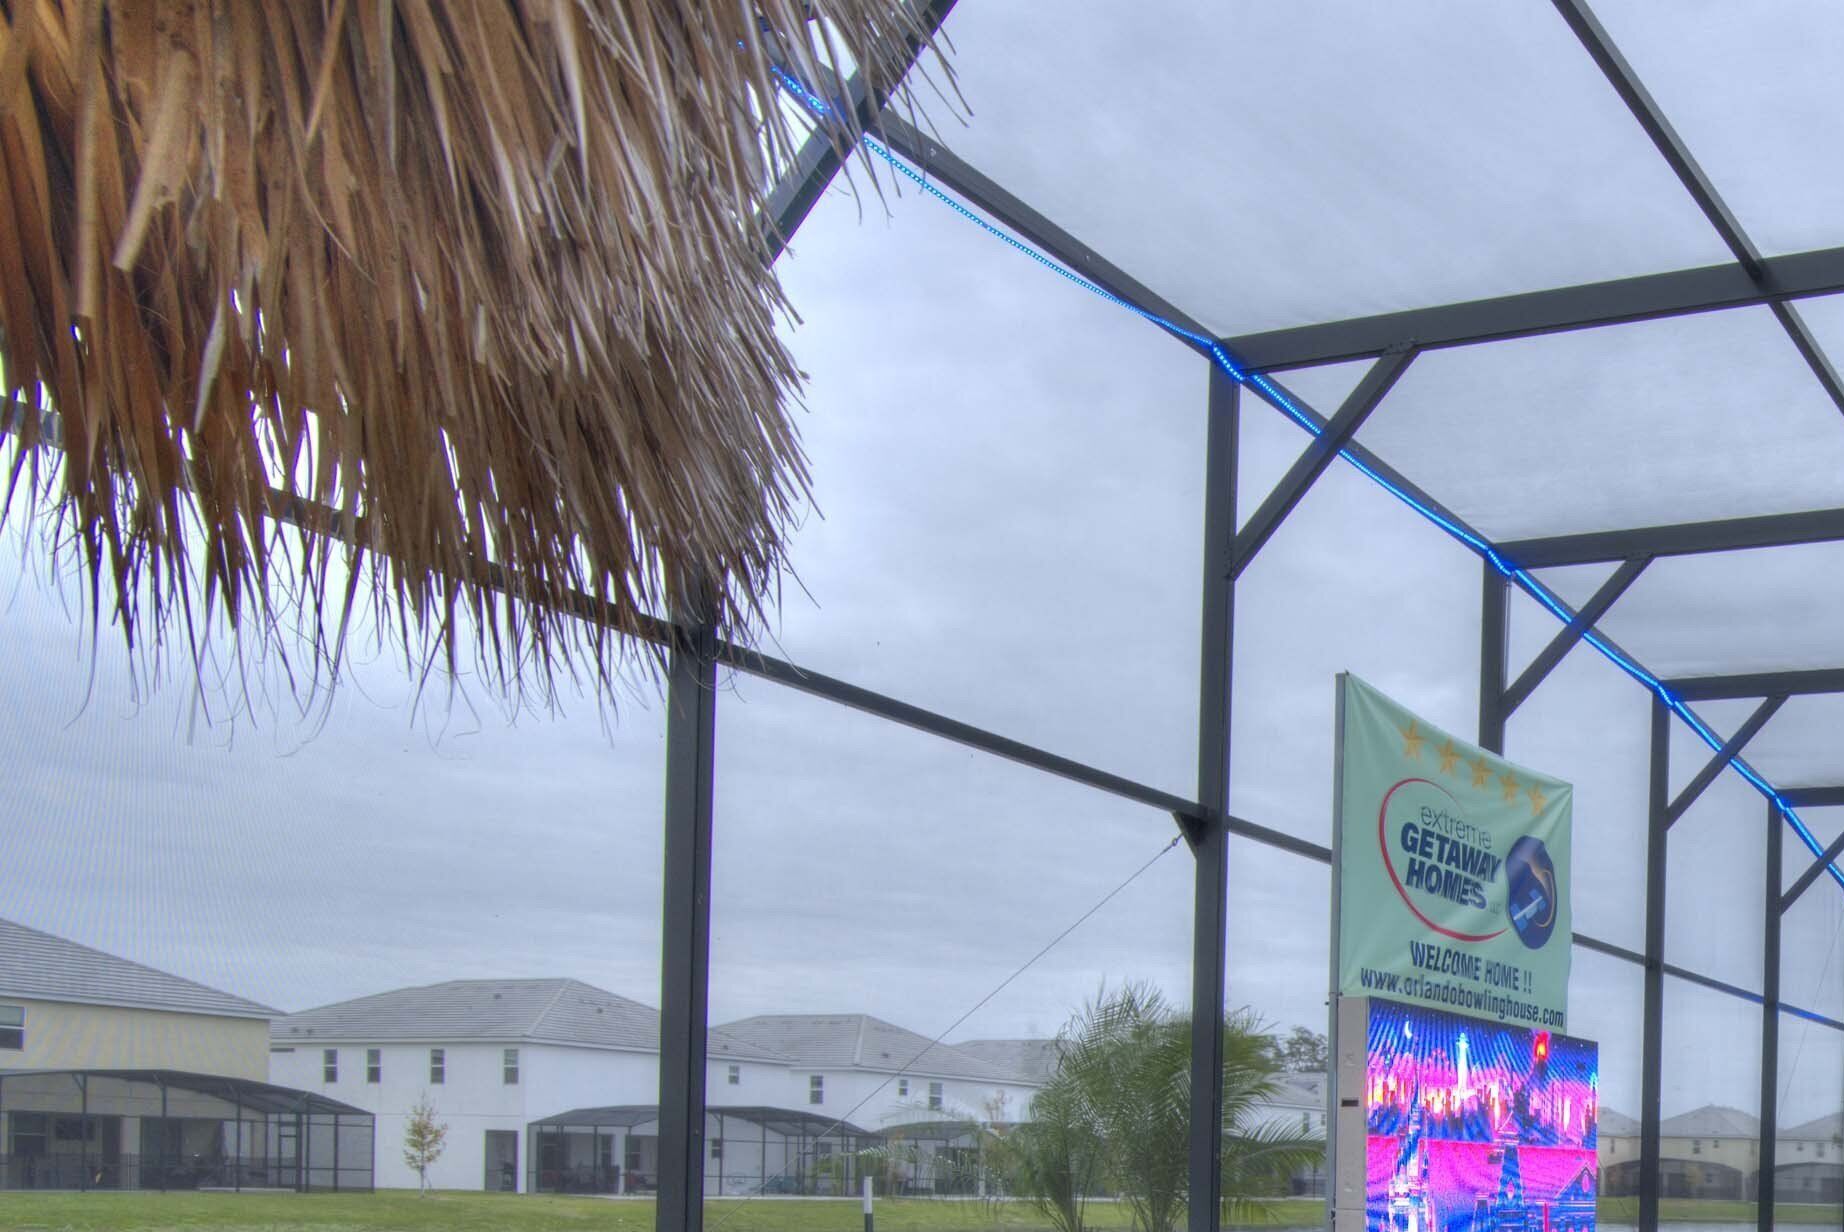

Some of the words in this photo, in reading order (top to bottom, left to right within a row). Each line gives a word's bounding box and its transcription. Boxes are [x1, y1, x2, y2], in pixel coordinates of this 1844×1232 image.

[1401, 822, 1502, 883] GETAWAY
[1421, 806, 1492, 850] extreme
[1406, 857, 1487, 909] HOMES
[1410, 941, 1482, 981] WELCOME
[1485, 961, 1520, 991] HOME
[1361, 968, 1564, 1027] www.orlandobowlinghouse.com
